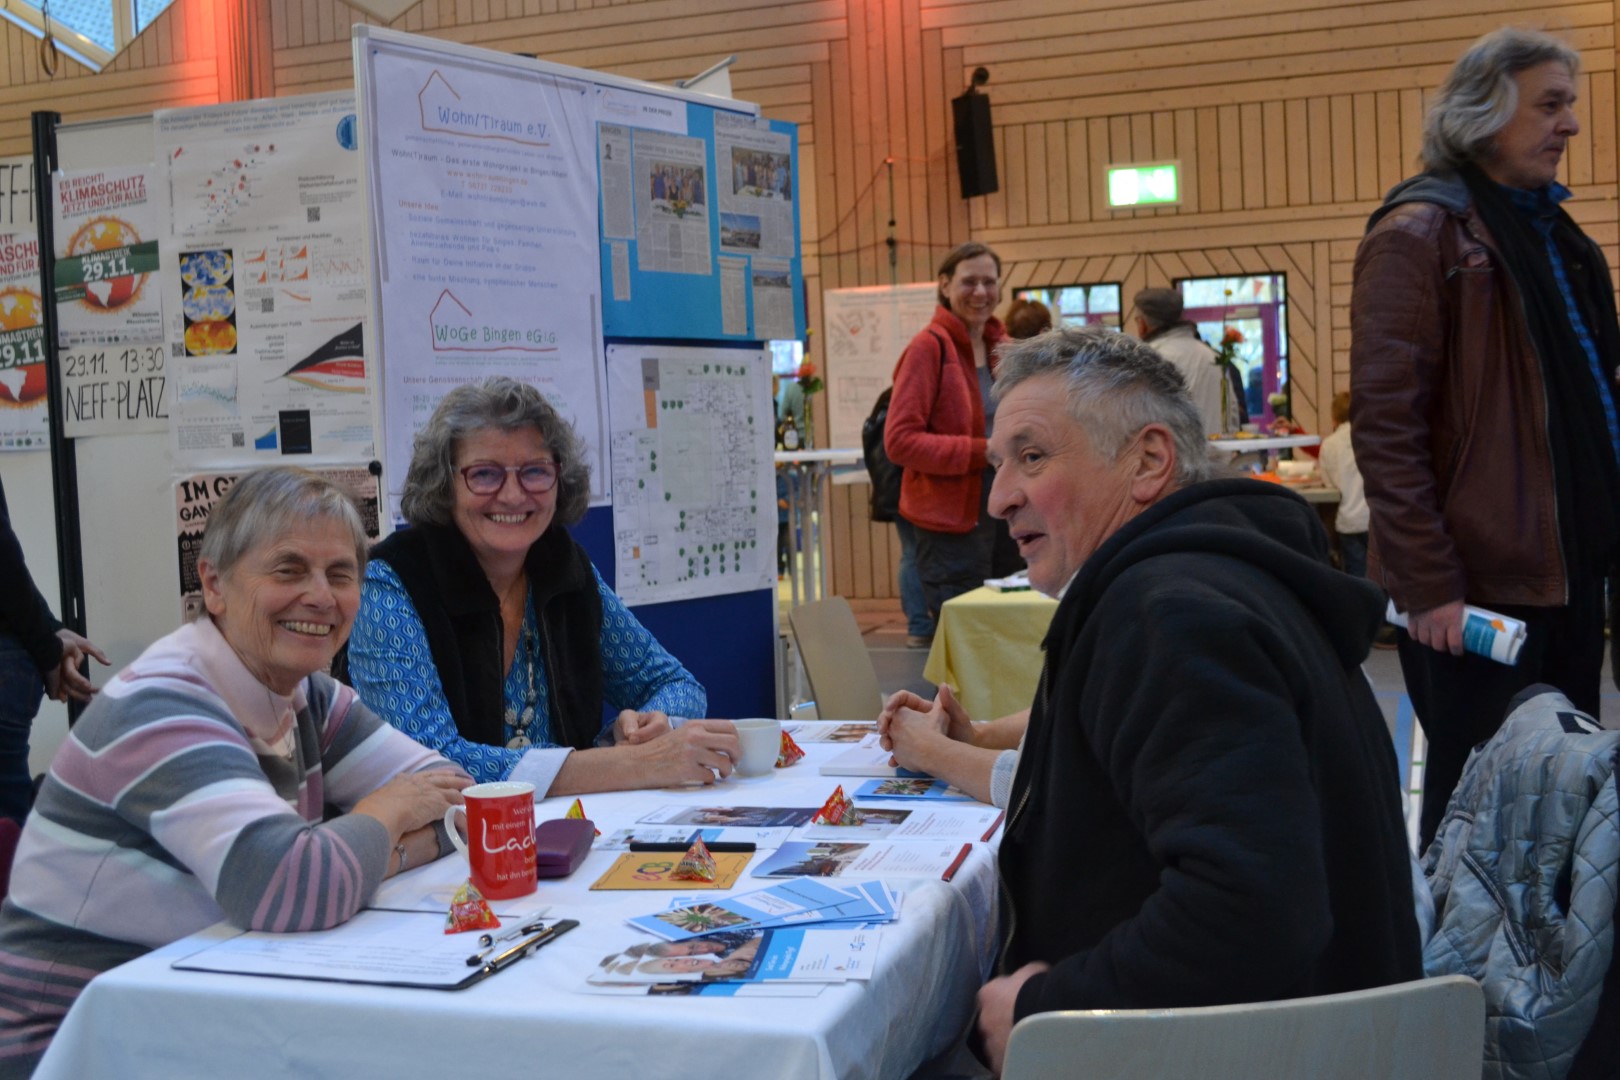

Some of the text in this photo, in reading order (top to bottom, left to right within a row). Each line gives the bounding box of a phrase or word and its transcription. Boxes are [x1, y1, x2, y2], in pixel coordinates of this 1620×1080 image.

[60, 174, 146, 204] KLIMASCHUTZ
[88, 198, 106, 209] UND
[124, 188, 146, 202] ALLE!
[82, 248, 131, 264] KLIMASTREIK
[82, 257, 135, 282] 29.11.
[434, 324, 477, 343] WoGe
[482, 326, 522, 344] Bingen
[526, 328, 542, 343] eG
[0, 338, 46, 368] 9.11
[66, 347, 164, 377] 29.11. 13:30
[66, 376, 169, 422] NEFF-PLATZ
[180, 479, 210, 504] IM
[180, 500, 216, 522] GAN
[492, 820, 526, 831] mit einem
